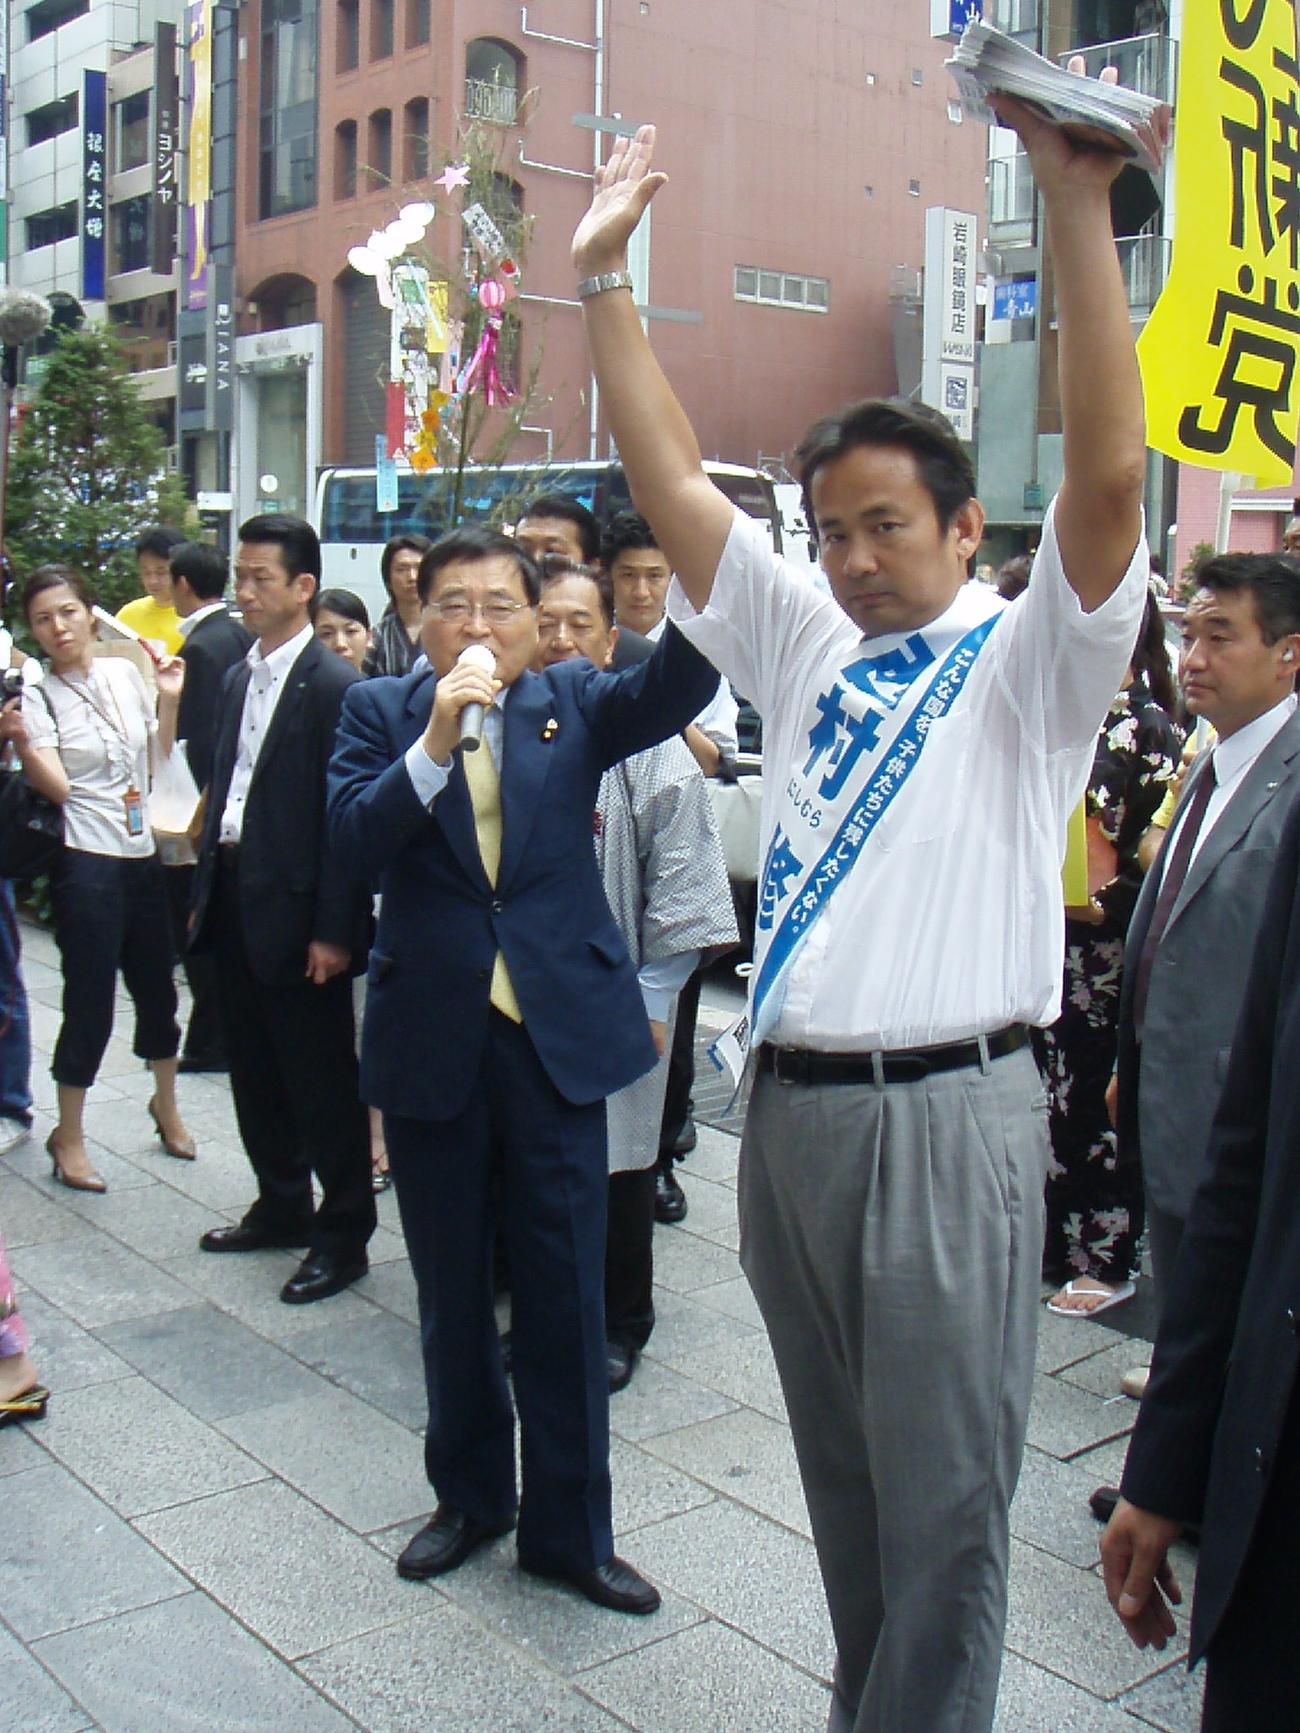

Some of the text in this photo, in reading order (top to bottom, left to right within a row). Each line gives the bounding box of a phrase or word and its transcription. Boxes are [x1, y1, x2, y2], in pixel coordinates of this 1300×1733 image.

[157, 134, 173, 205] ヨシノヤ
[786, 777, 823, 830] にしむら
